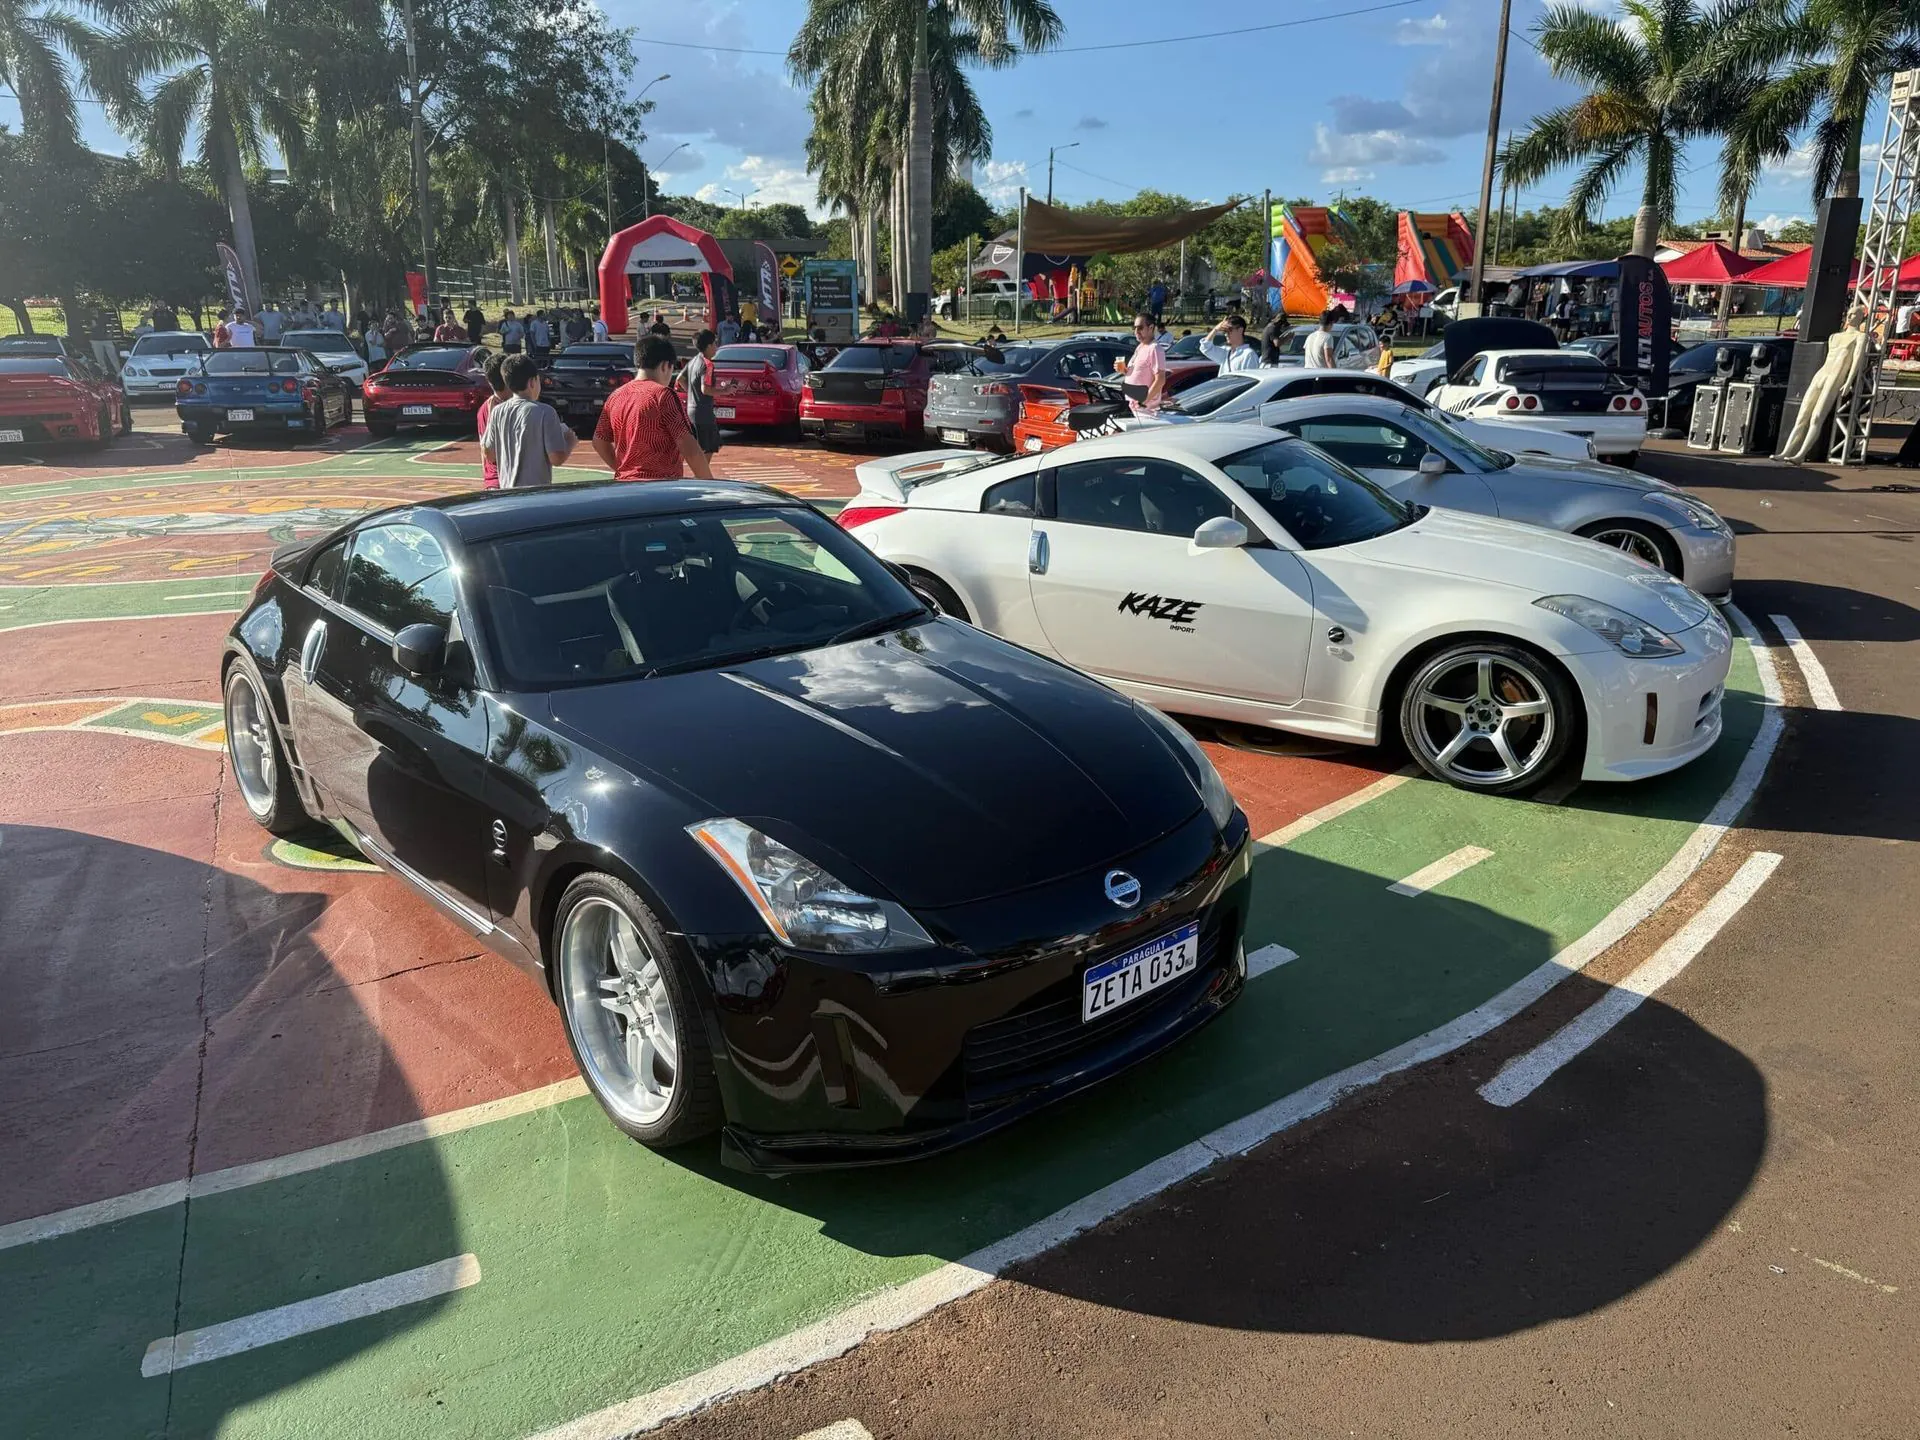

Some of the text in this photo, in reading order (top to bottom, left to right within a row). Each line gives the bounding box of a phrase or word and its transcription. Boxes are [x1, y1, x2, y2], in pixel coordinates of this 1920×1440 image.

[760, 268, 775, 310] MTR
[1117, 590, 1206, 624] KAZE
[1169, 624, 1196, 634] IMPORT
[1111, 880, 1139, 896] NISSAN
[1122, 940, 1166, 967] PARAGUAY
[1089, 943, 1186, 1014] ZETA 033
